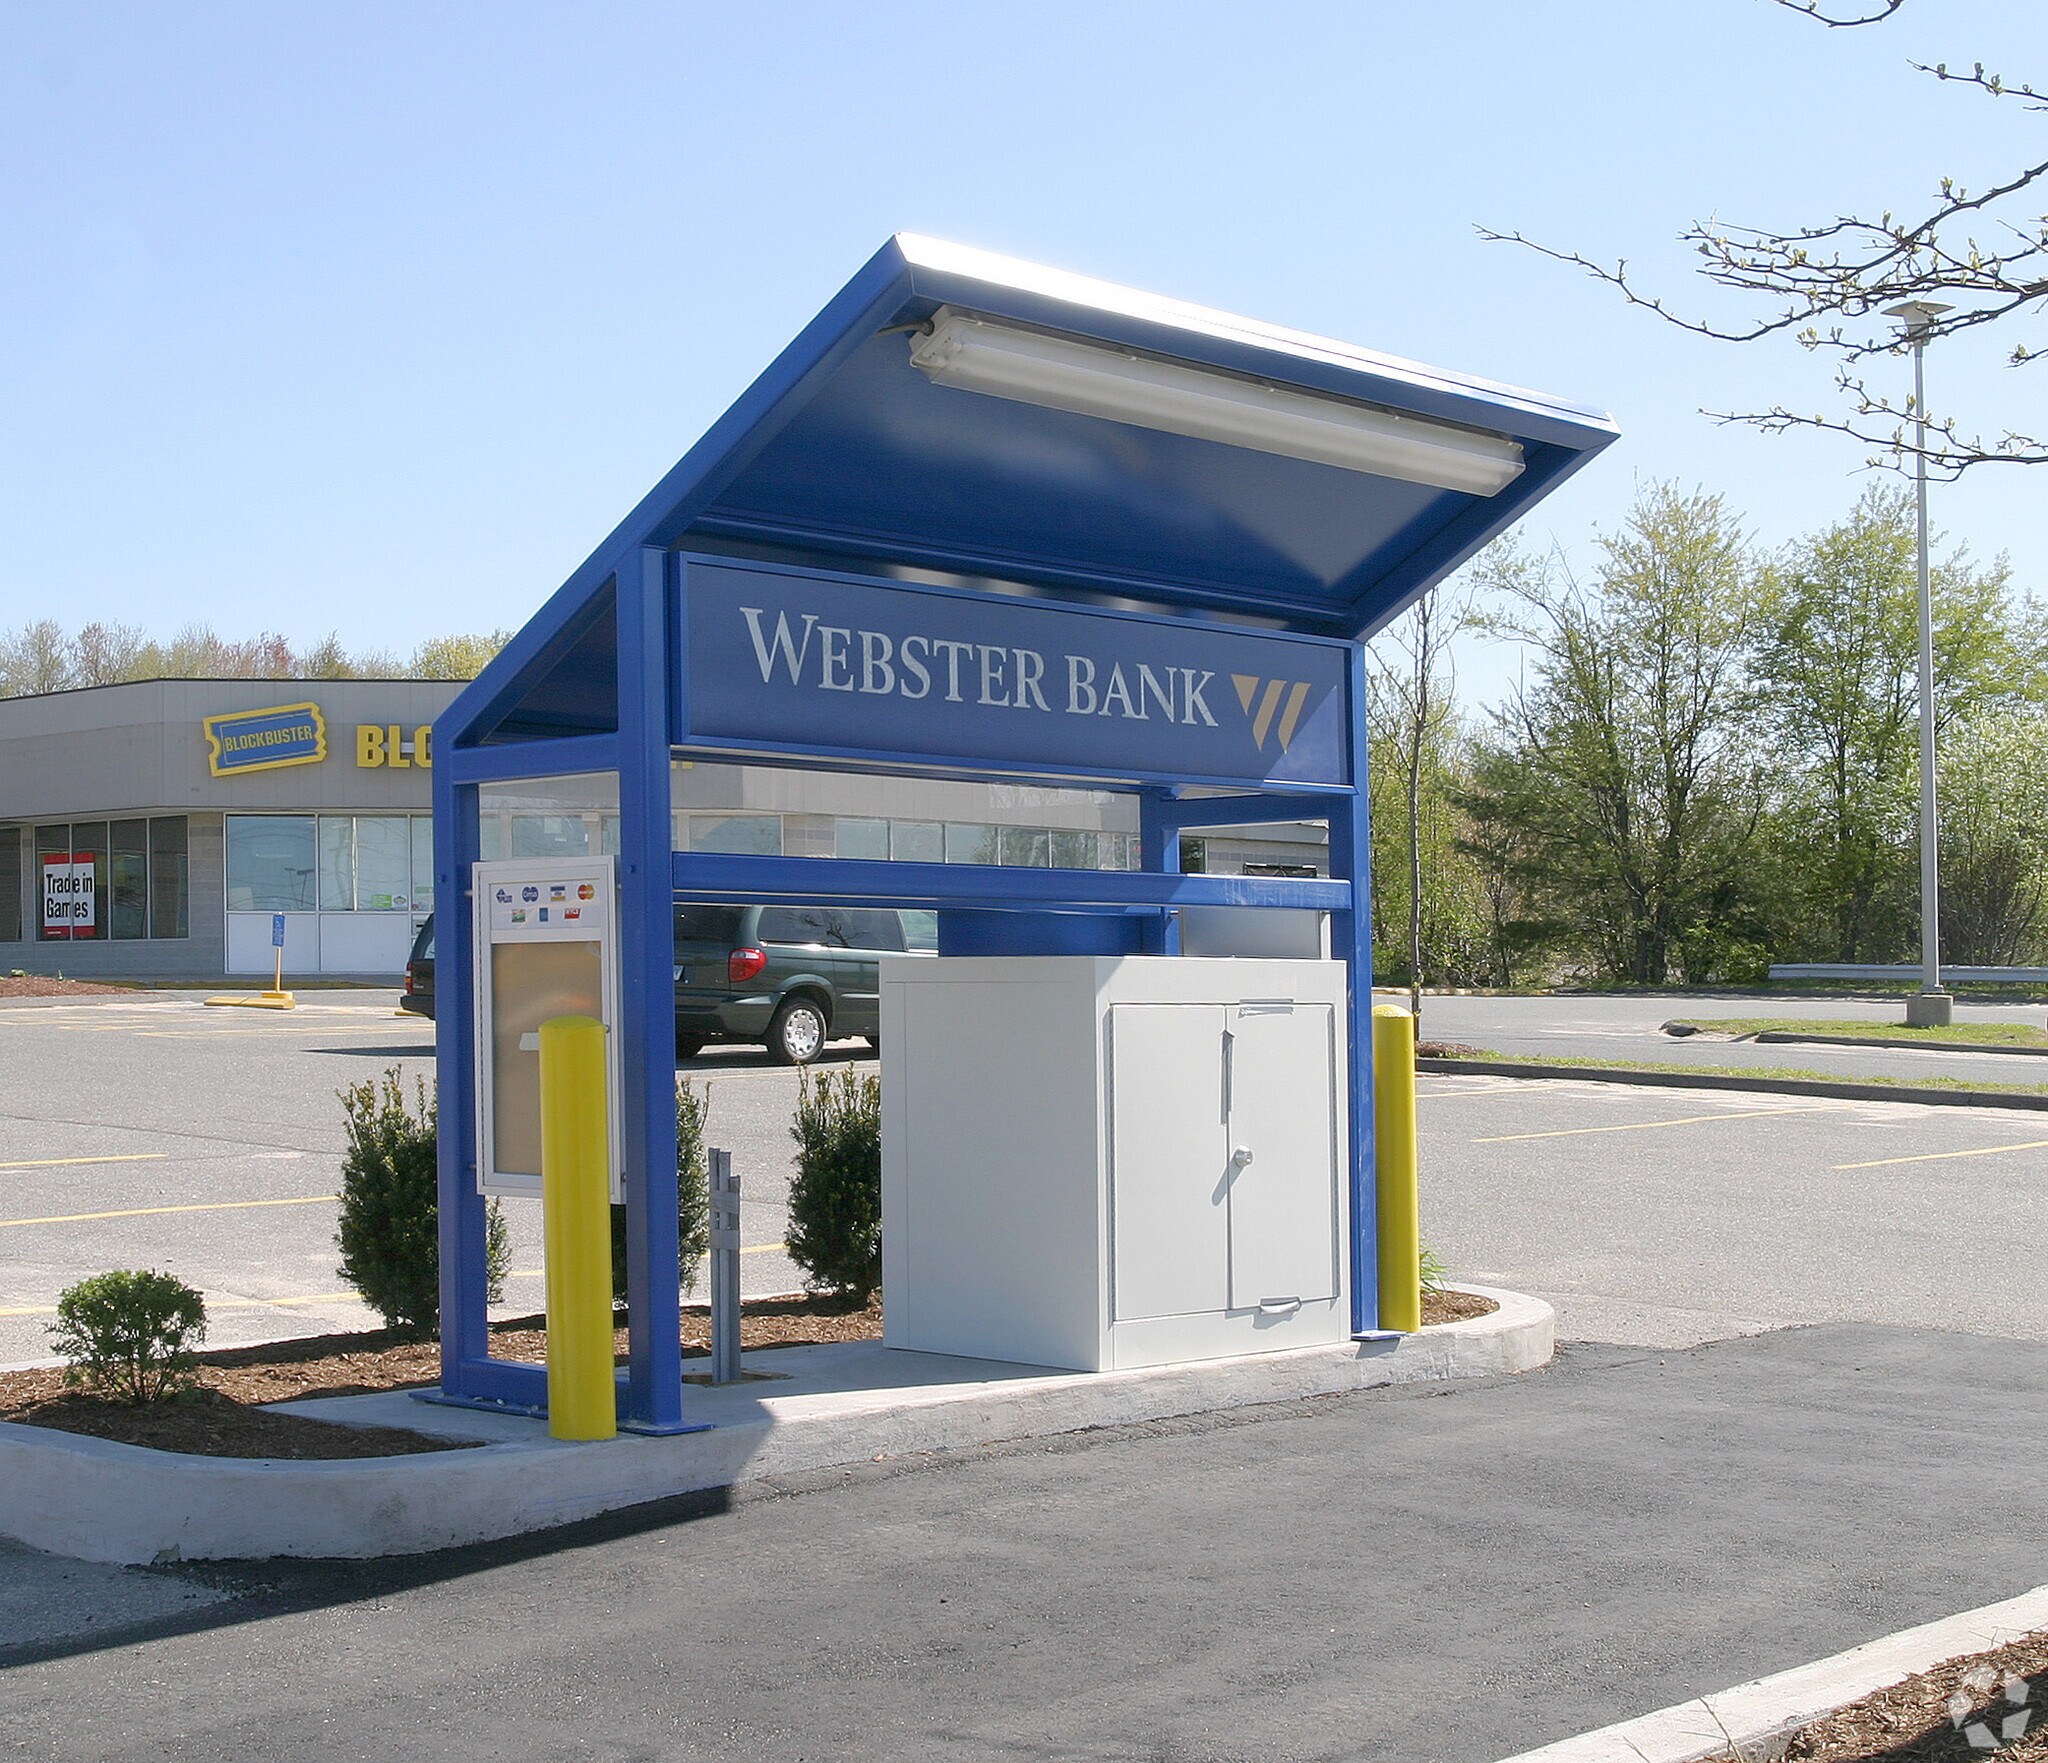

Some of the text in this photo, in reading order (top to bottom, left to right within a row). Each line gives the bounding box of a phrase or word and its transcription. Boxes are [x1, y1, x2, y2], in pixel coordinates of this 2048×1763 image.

[739, 606, 1219, 727] WEBSTER BANK
[224, 725, 313, 752] BLOCKBUSTER
[46, 872, 93, 894] Trade in
